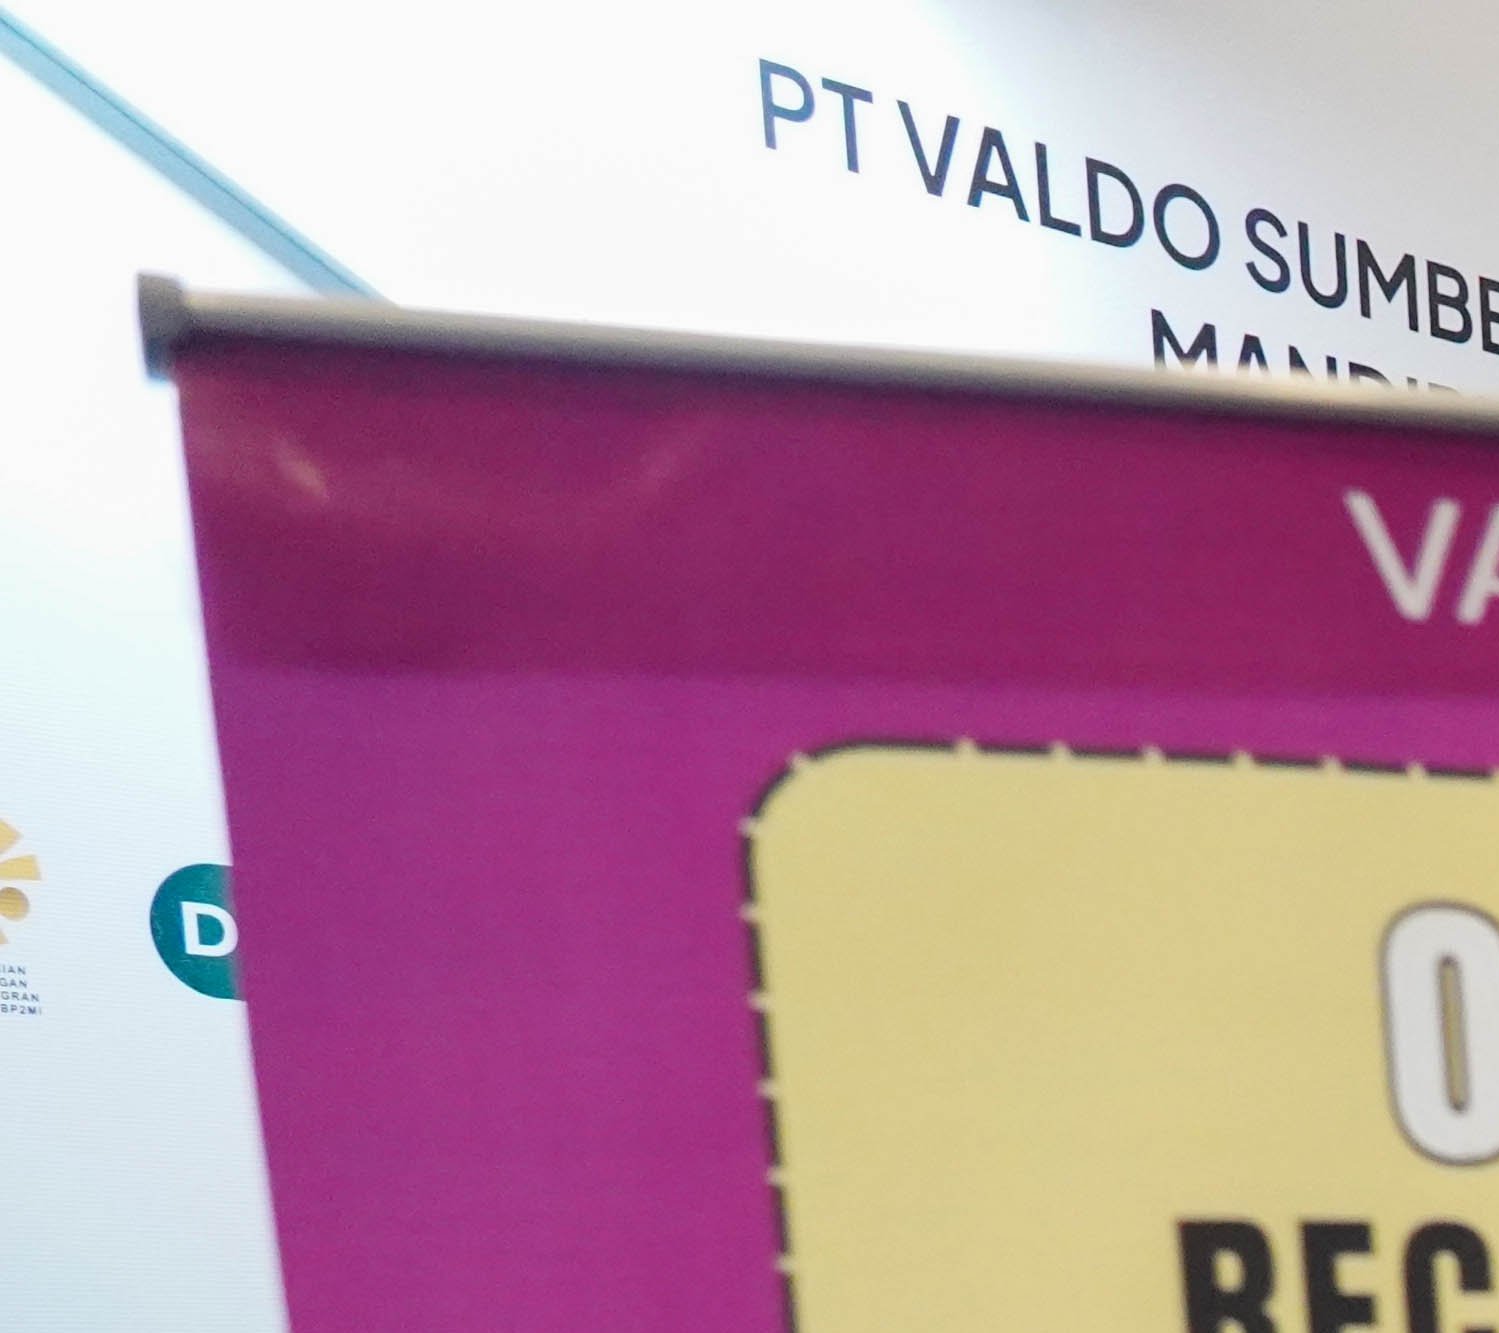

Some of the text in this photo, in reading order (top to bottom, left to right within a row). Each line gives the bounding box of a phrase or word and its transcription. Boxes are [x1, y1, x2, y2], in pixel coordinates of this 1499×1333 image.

[757, 57, 875, 174] PT
[895, 98, 1221, 272] VALDO
[0, 963, 27, 976] IAN
